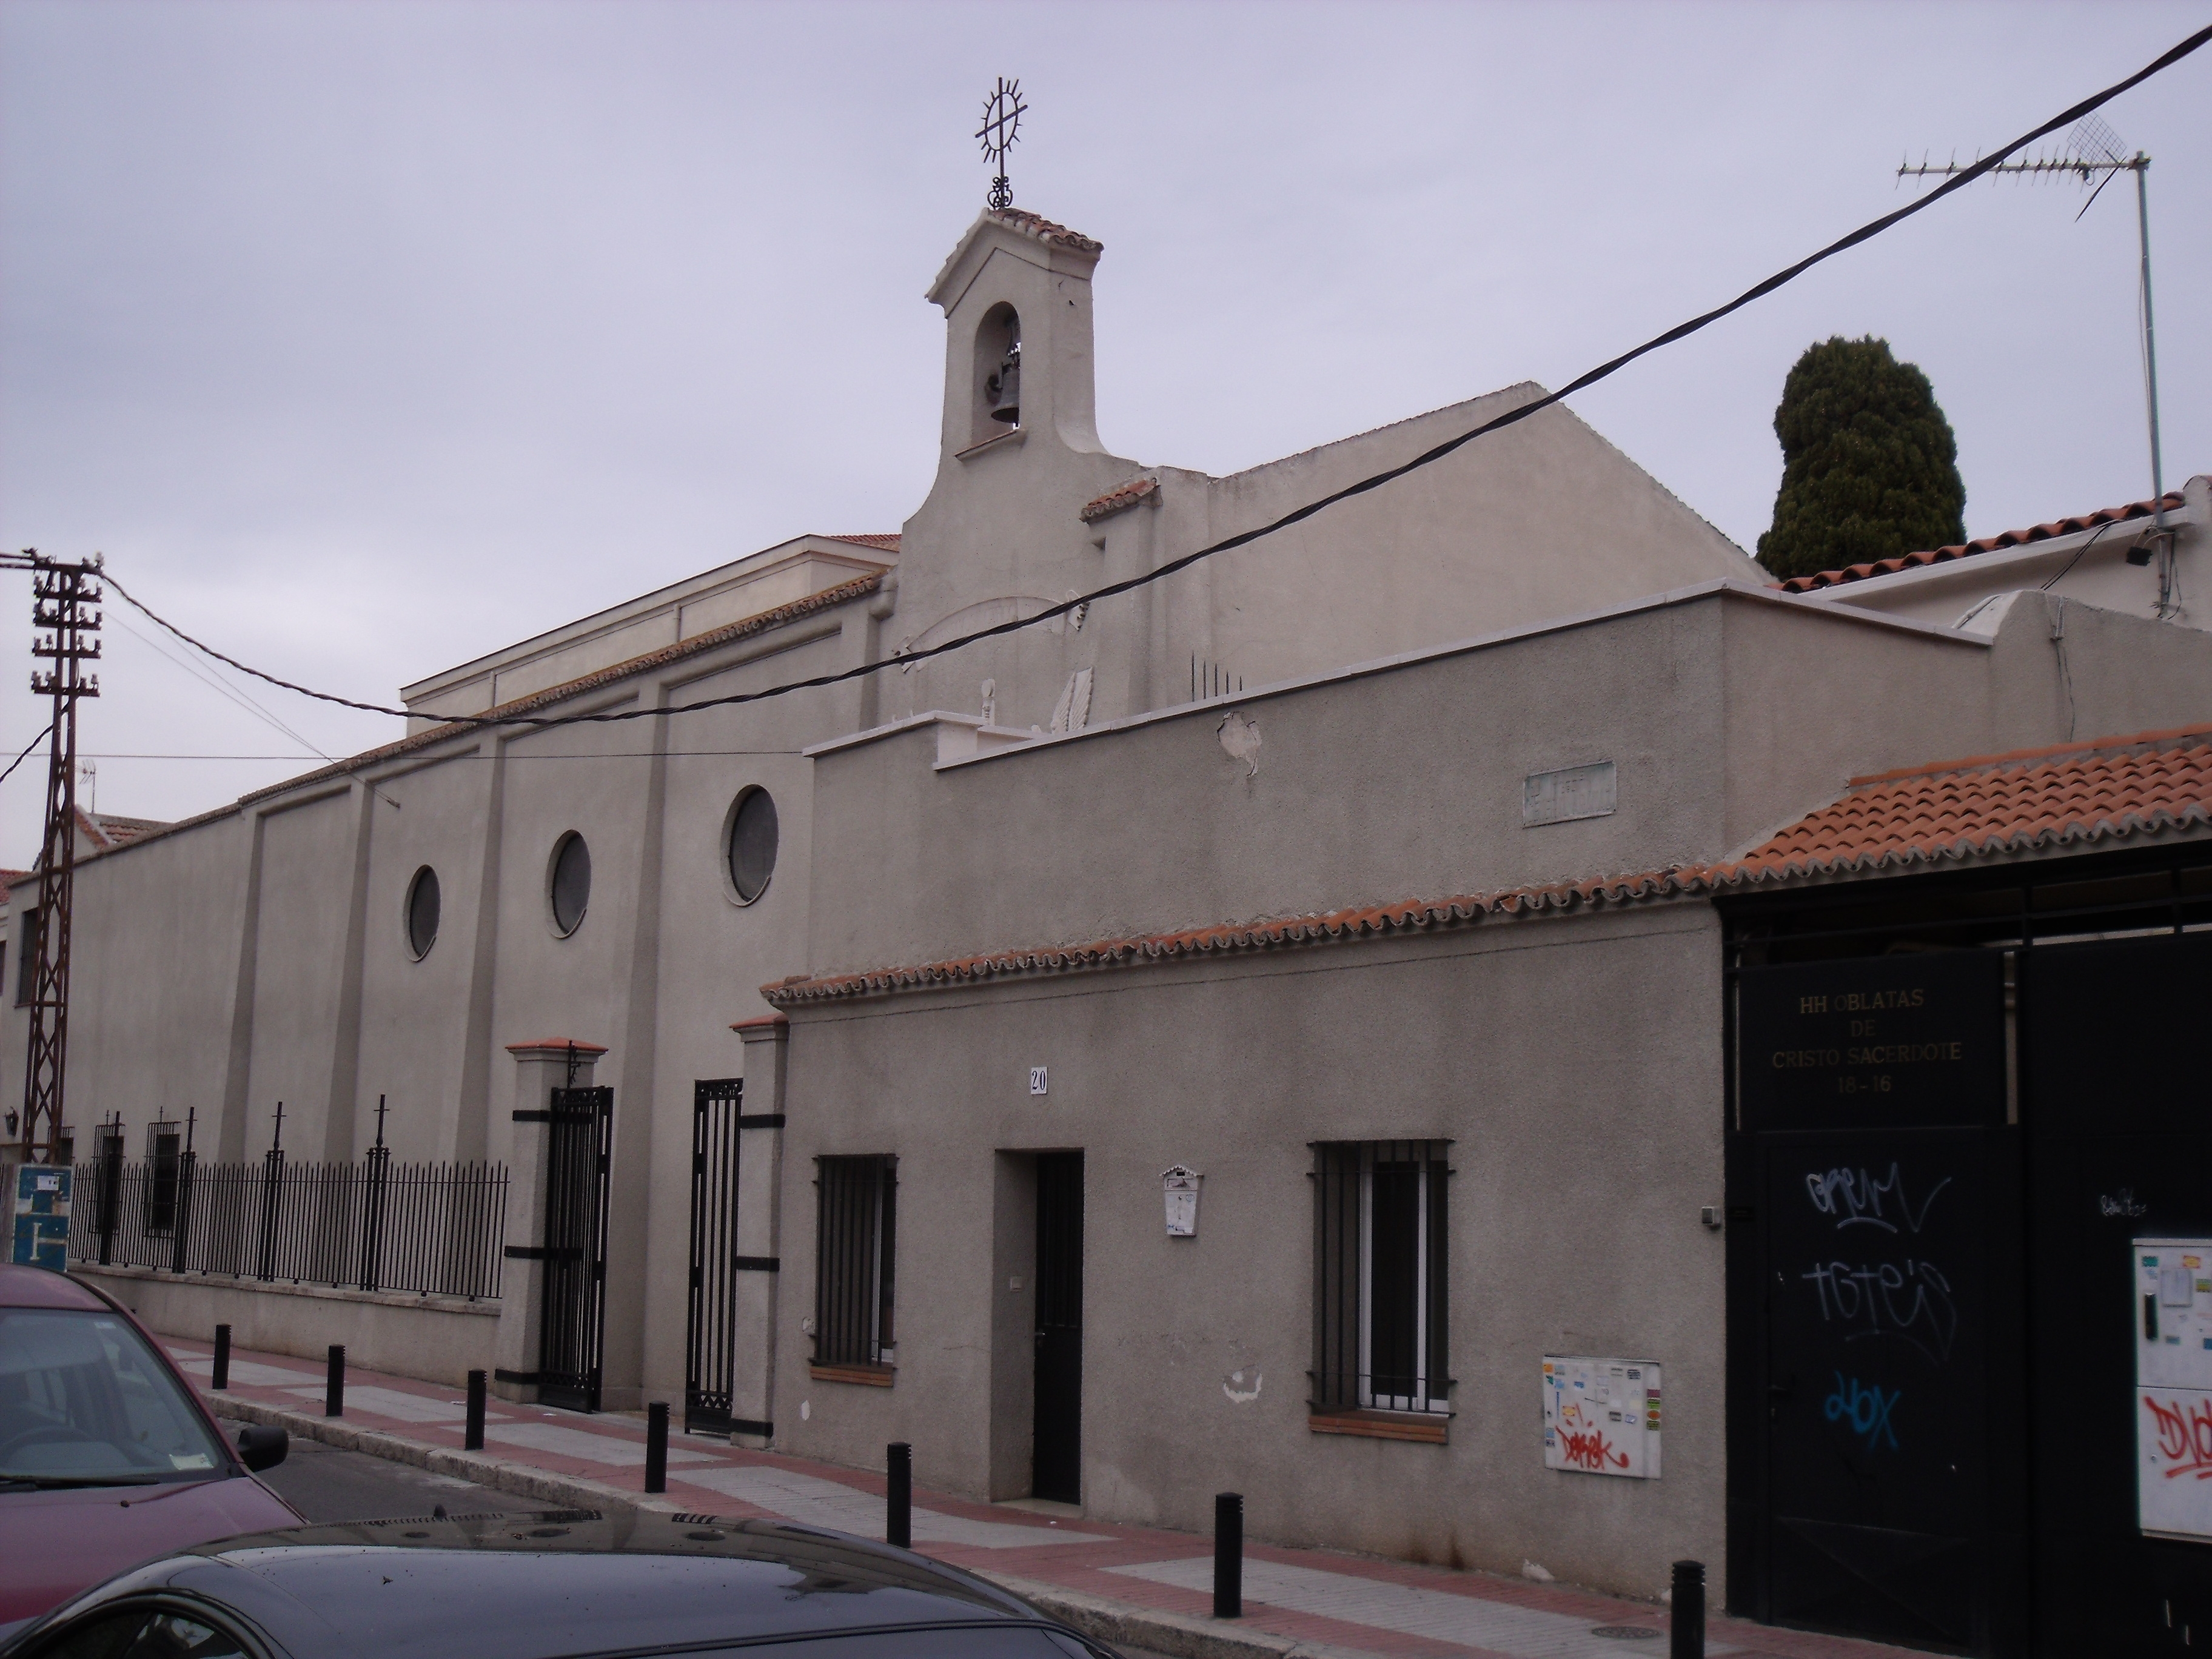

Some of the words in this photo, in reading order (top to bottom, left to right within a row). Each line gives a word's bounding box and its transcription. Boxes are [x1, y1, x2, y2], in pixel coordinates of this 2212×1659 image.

[1800, 996, 1828, 1014] HH
[1834, 989, 1926, 1012] OBLATAS
[1851, 1019, 1877, 1037] DE
[1772, 1049, 1840, 1068] CRISTO
[1847, 1042, 1962, 1065] SACERDOTE
[1032, 1070, 1046, 1090] 20
